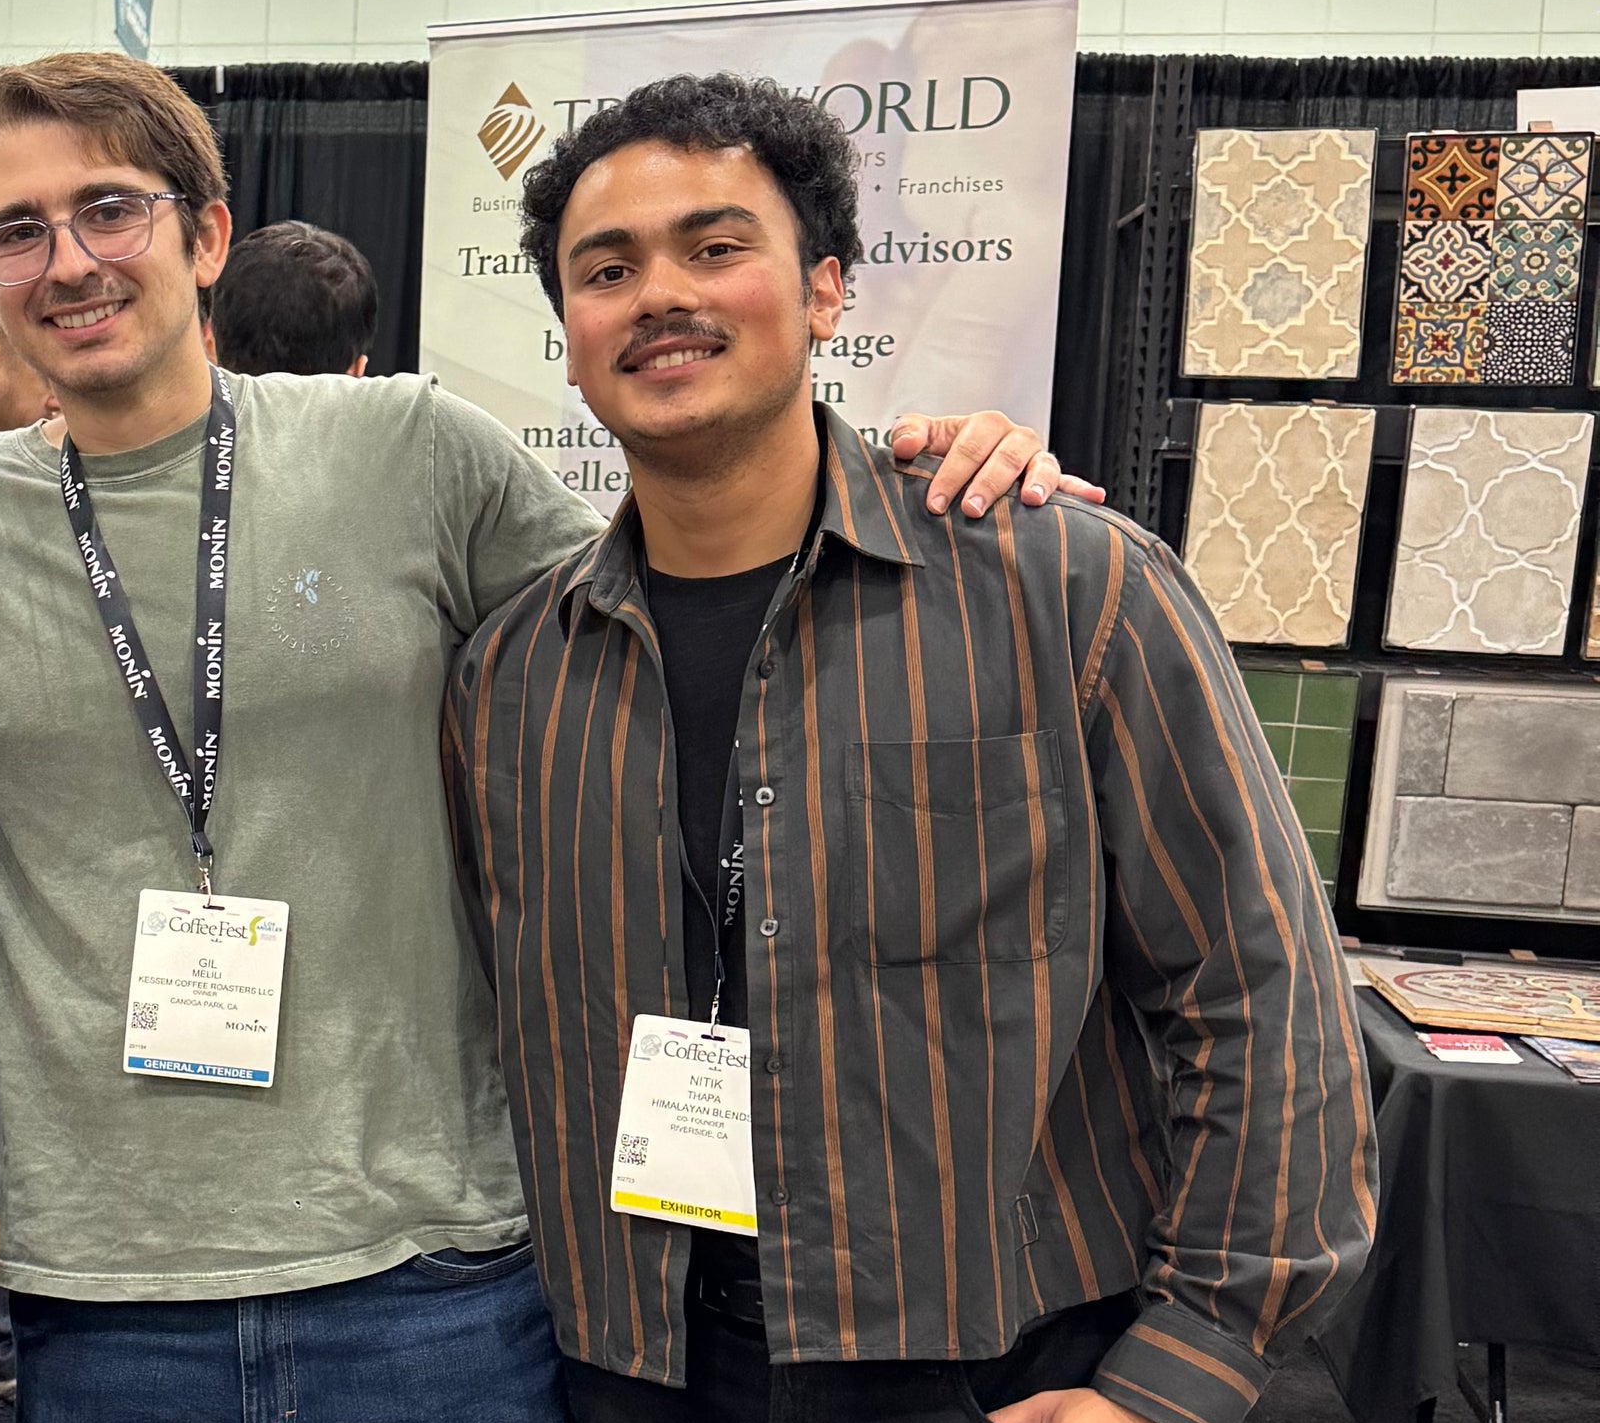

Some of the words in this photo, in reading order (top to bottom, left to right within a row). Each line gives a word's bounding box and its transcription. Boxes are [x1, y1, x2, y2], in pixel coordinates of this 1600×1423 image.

[897, 176, 1005, 196] Franchises
[209, 425, 234, 490] MONIN
[201, 516, 227, 590] MONIN
[79, 532, 116, 599] MONIN
[109, 624, 152, 699] MONIN
[196, 620, 222, 699] MONIN
[149, 726, 193, 798] MONIN
[196, 732, 218, 811] MONIN
[198, 958, 218, 969] GIL
[191, 969, 223, 980] MELILI
[138, 976, 173, 987] KESSEM
[174, 978, 209, 991] COFFEE
[210, 982, 257, 995] ROASTERS
[258, 987, 275, 997] LLC
[169, 997, 202, 1007] CANOGA
[227, 1003, 239, 1011] CA
[143, 1059, 194, 1073] GENERAL
[196, 1065, 254, 1079] ATTENDEE
[689, 1075, 724, 1090] NITIK
[651, 1098, 711, 1116] HIMALAYAN
[687, 1090, 722, 1104] THAPA
[716, 1132, 729, 1140] CA
[660, 1199, 723, 1220] EXHIBITOR
